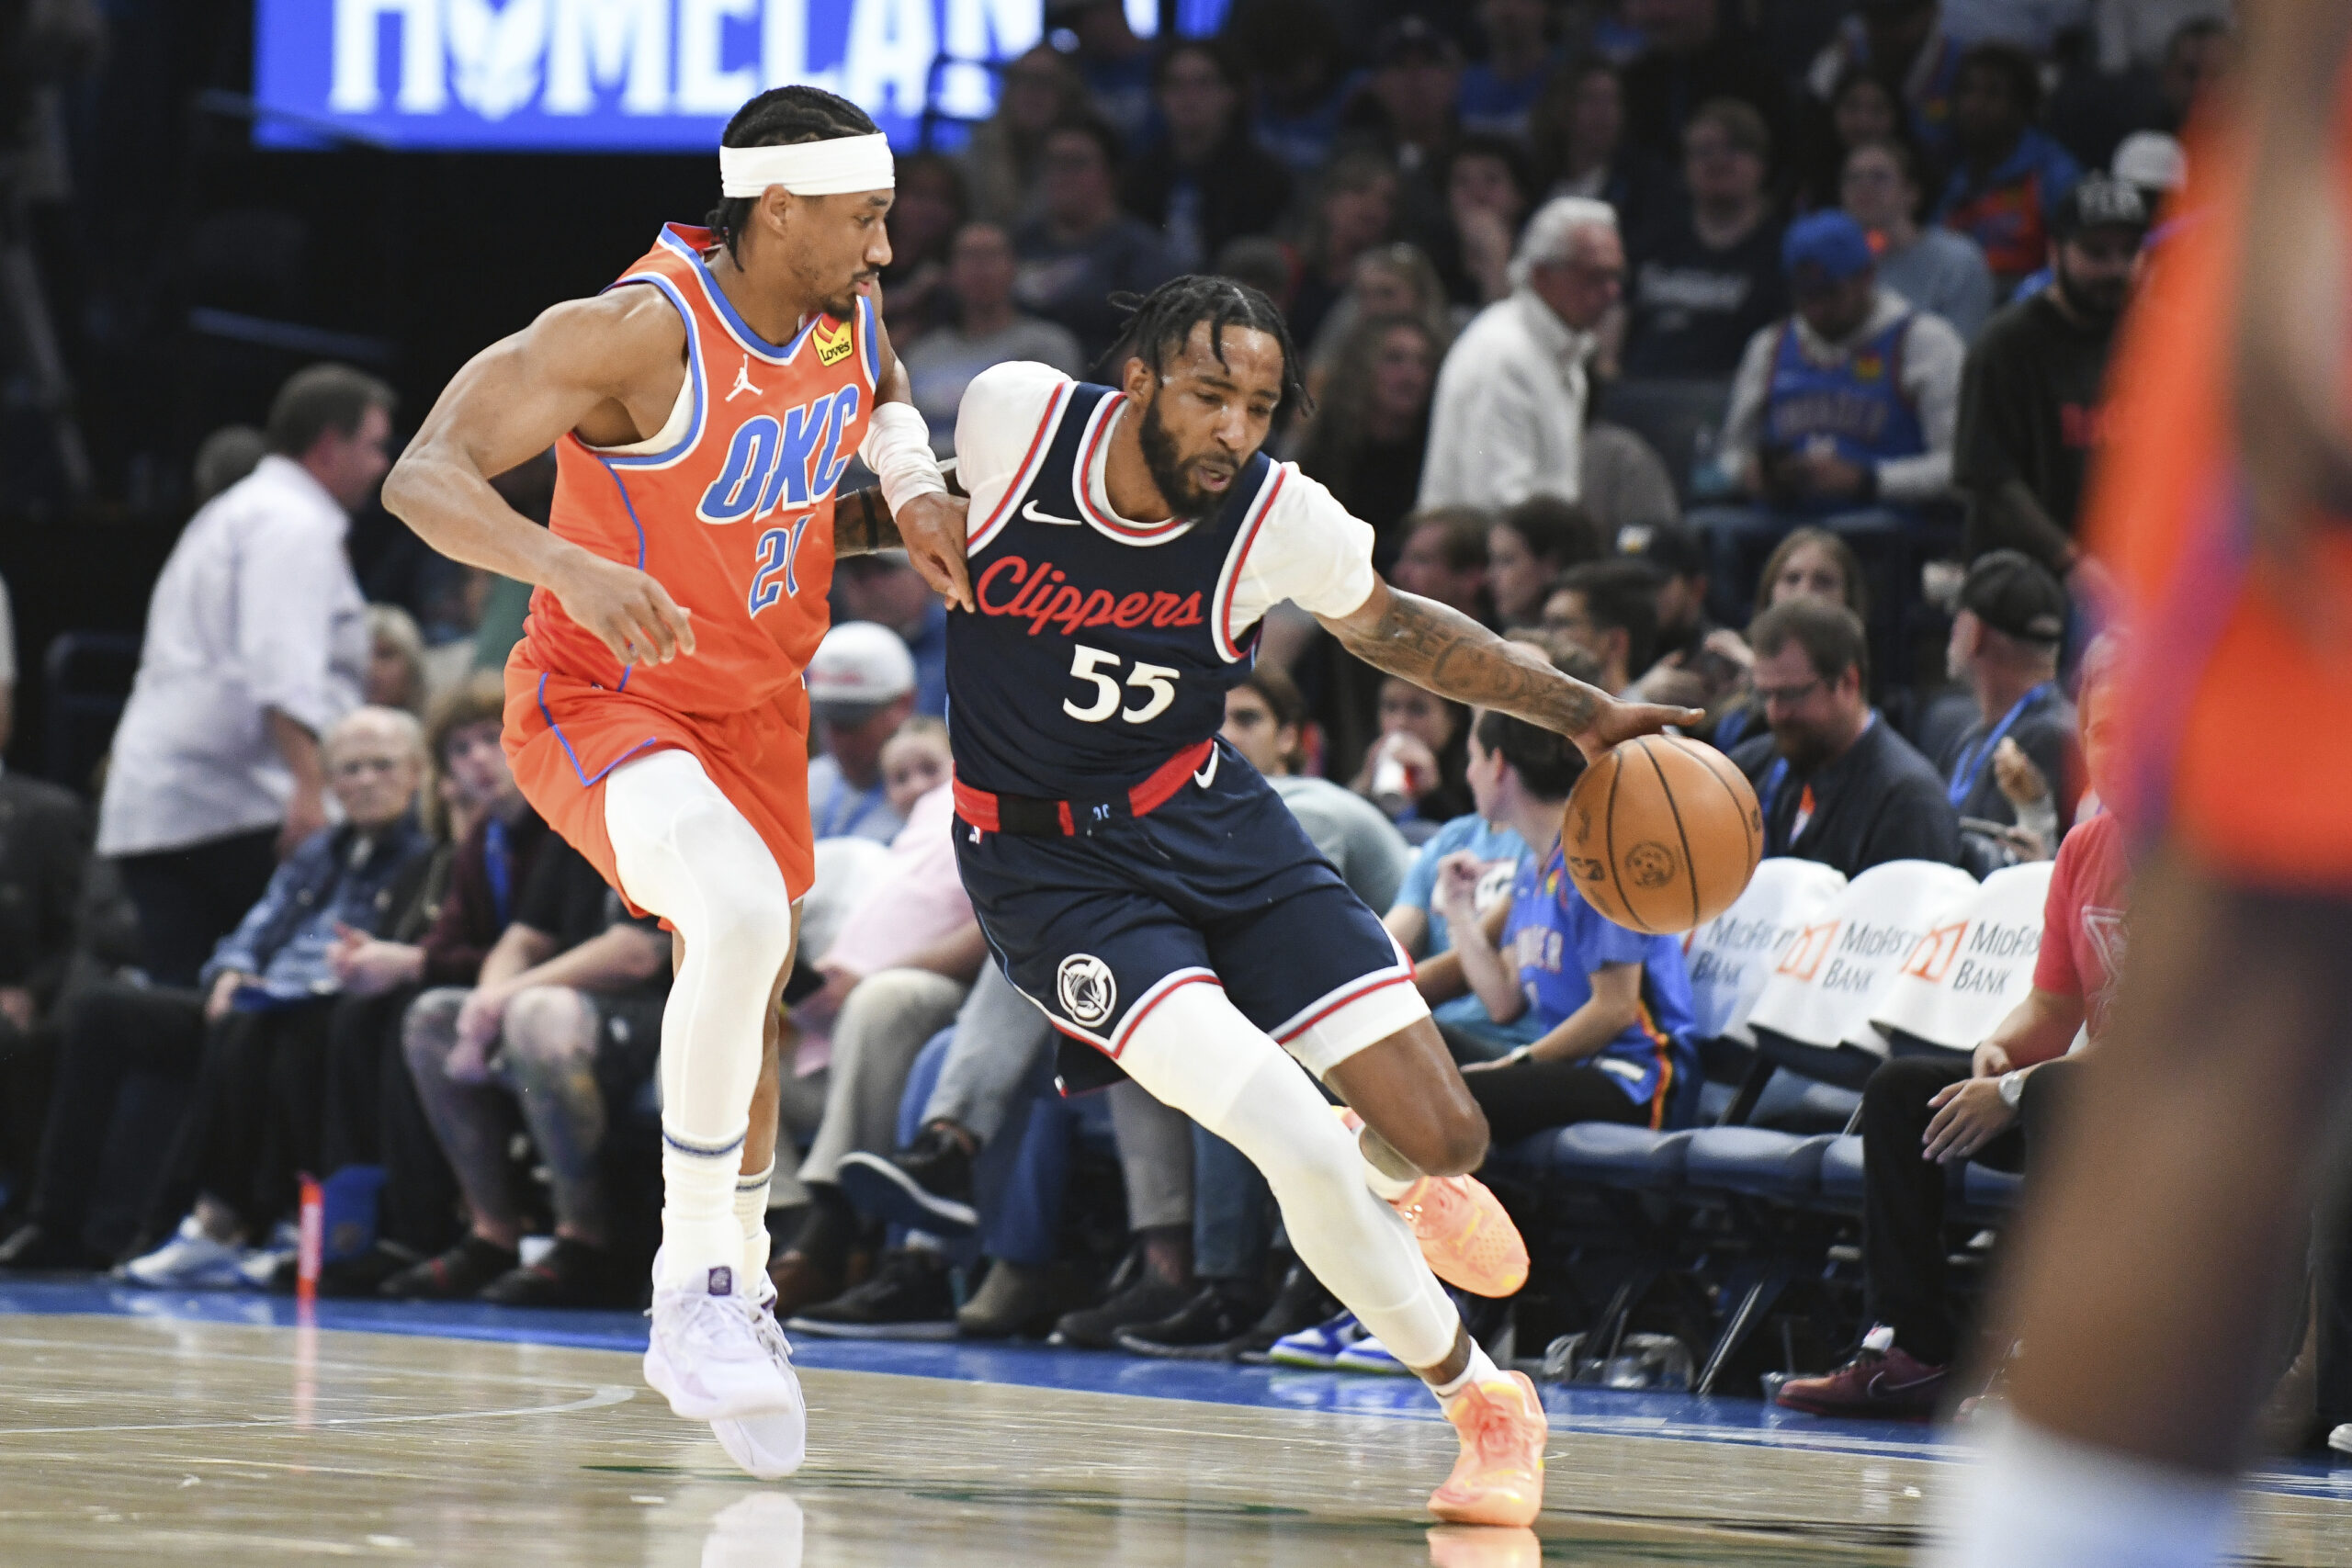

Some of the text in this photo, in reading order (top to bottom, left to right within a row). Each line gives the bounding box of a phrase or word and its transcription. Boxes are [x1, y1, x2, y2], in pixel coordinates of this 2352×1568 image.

[695, 383, 860, 525] OKC
[977, 555, 1204, 636] Clippers
[1062, 643, 1181, 724] 55
